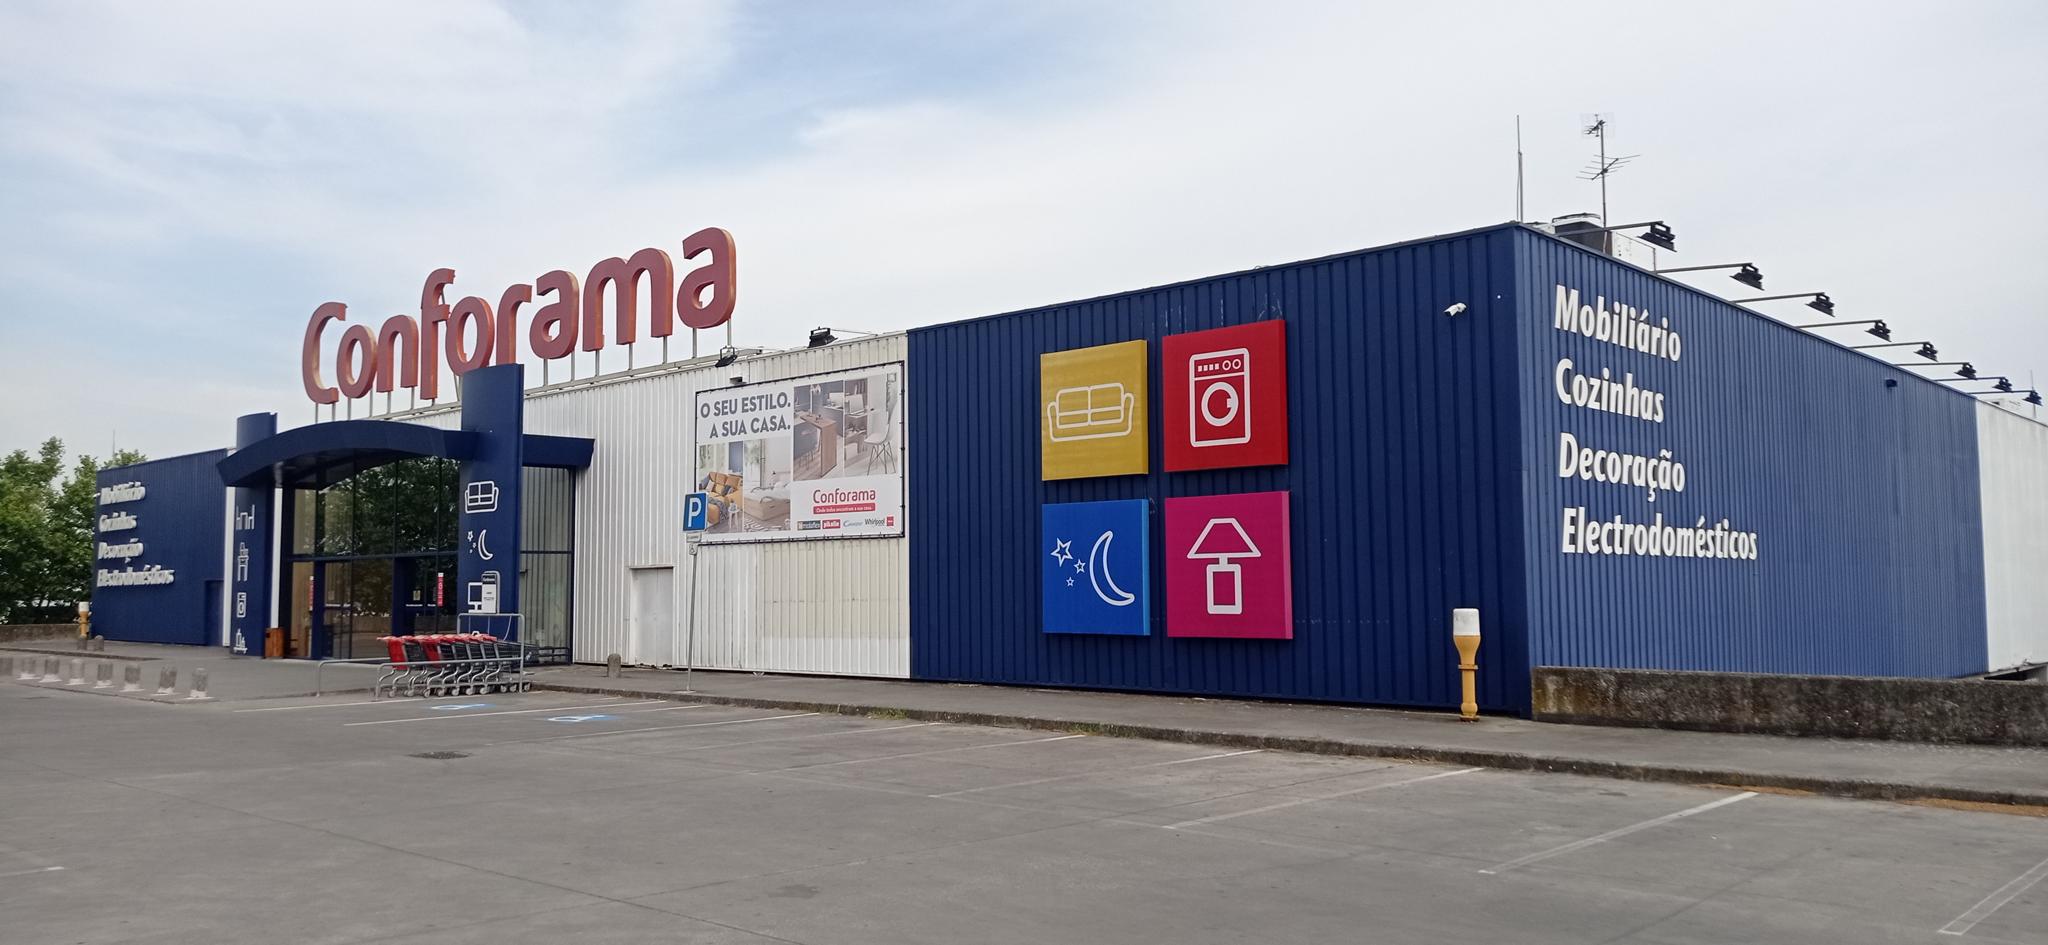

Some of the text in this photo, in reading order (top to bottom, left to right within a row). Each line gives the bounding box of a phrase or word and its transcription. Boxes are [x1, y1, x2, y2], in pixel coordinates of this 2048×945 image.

[302, 227, 737, 405] Conforama
[1554, 284, 1682, 362] Mobiliário
[700, 391, 791, 419] O SEU ESTILO.
[1555, 358, 1665, 424] Cozinhas
[709, 415, 791, 439] A SUA CASA.
[1559, 432, 1686, 502] Decoração
[687, 497, 702, 528] P
[813, 488, 876, 504] Conforama
[864, 517, 885, 527] Whirlpool
[1561, 506, 1758, 561] Electrodomésticos
